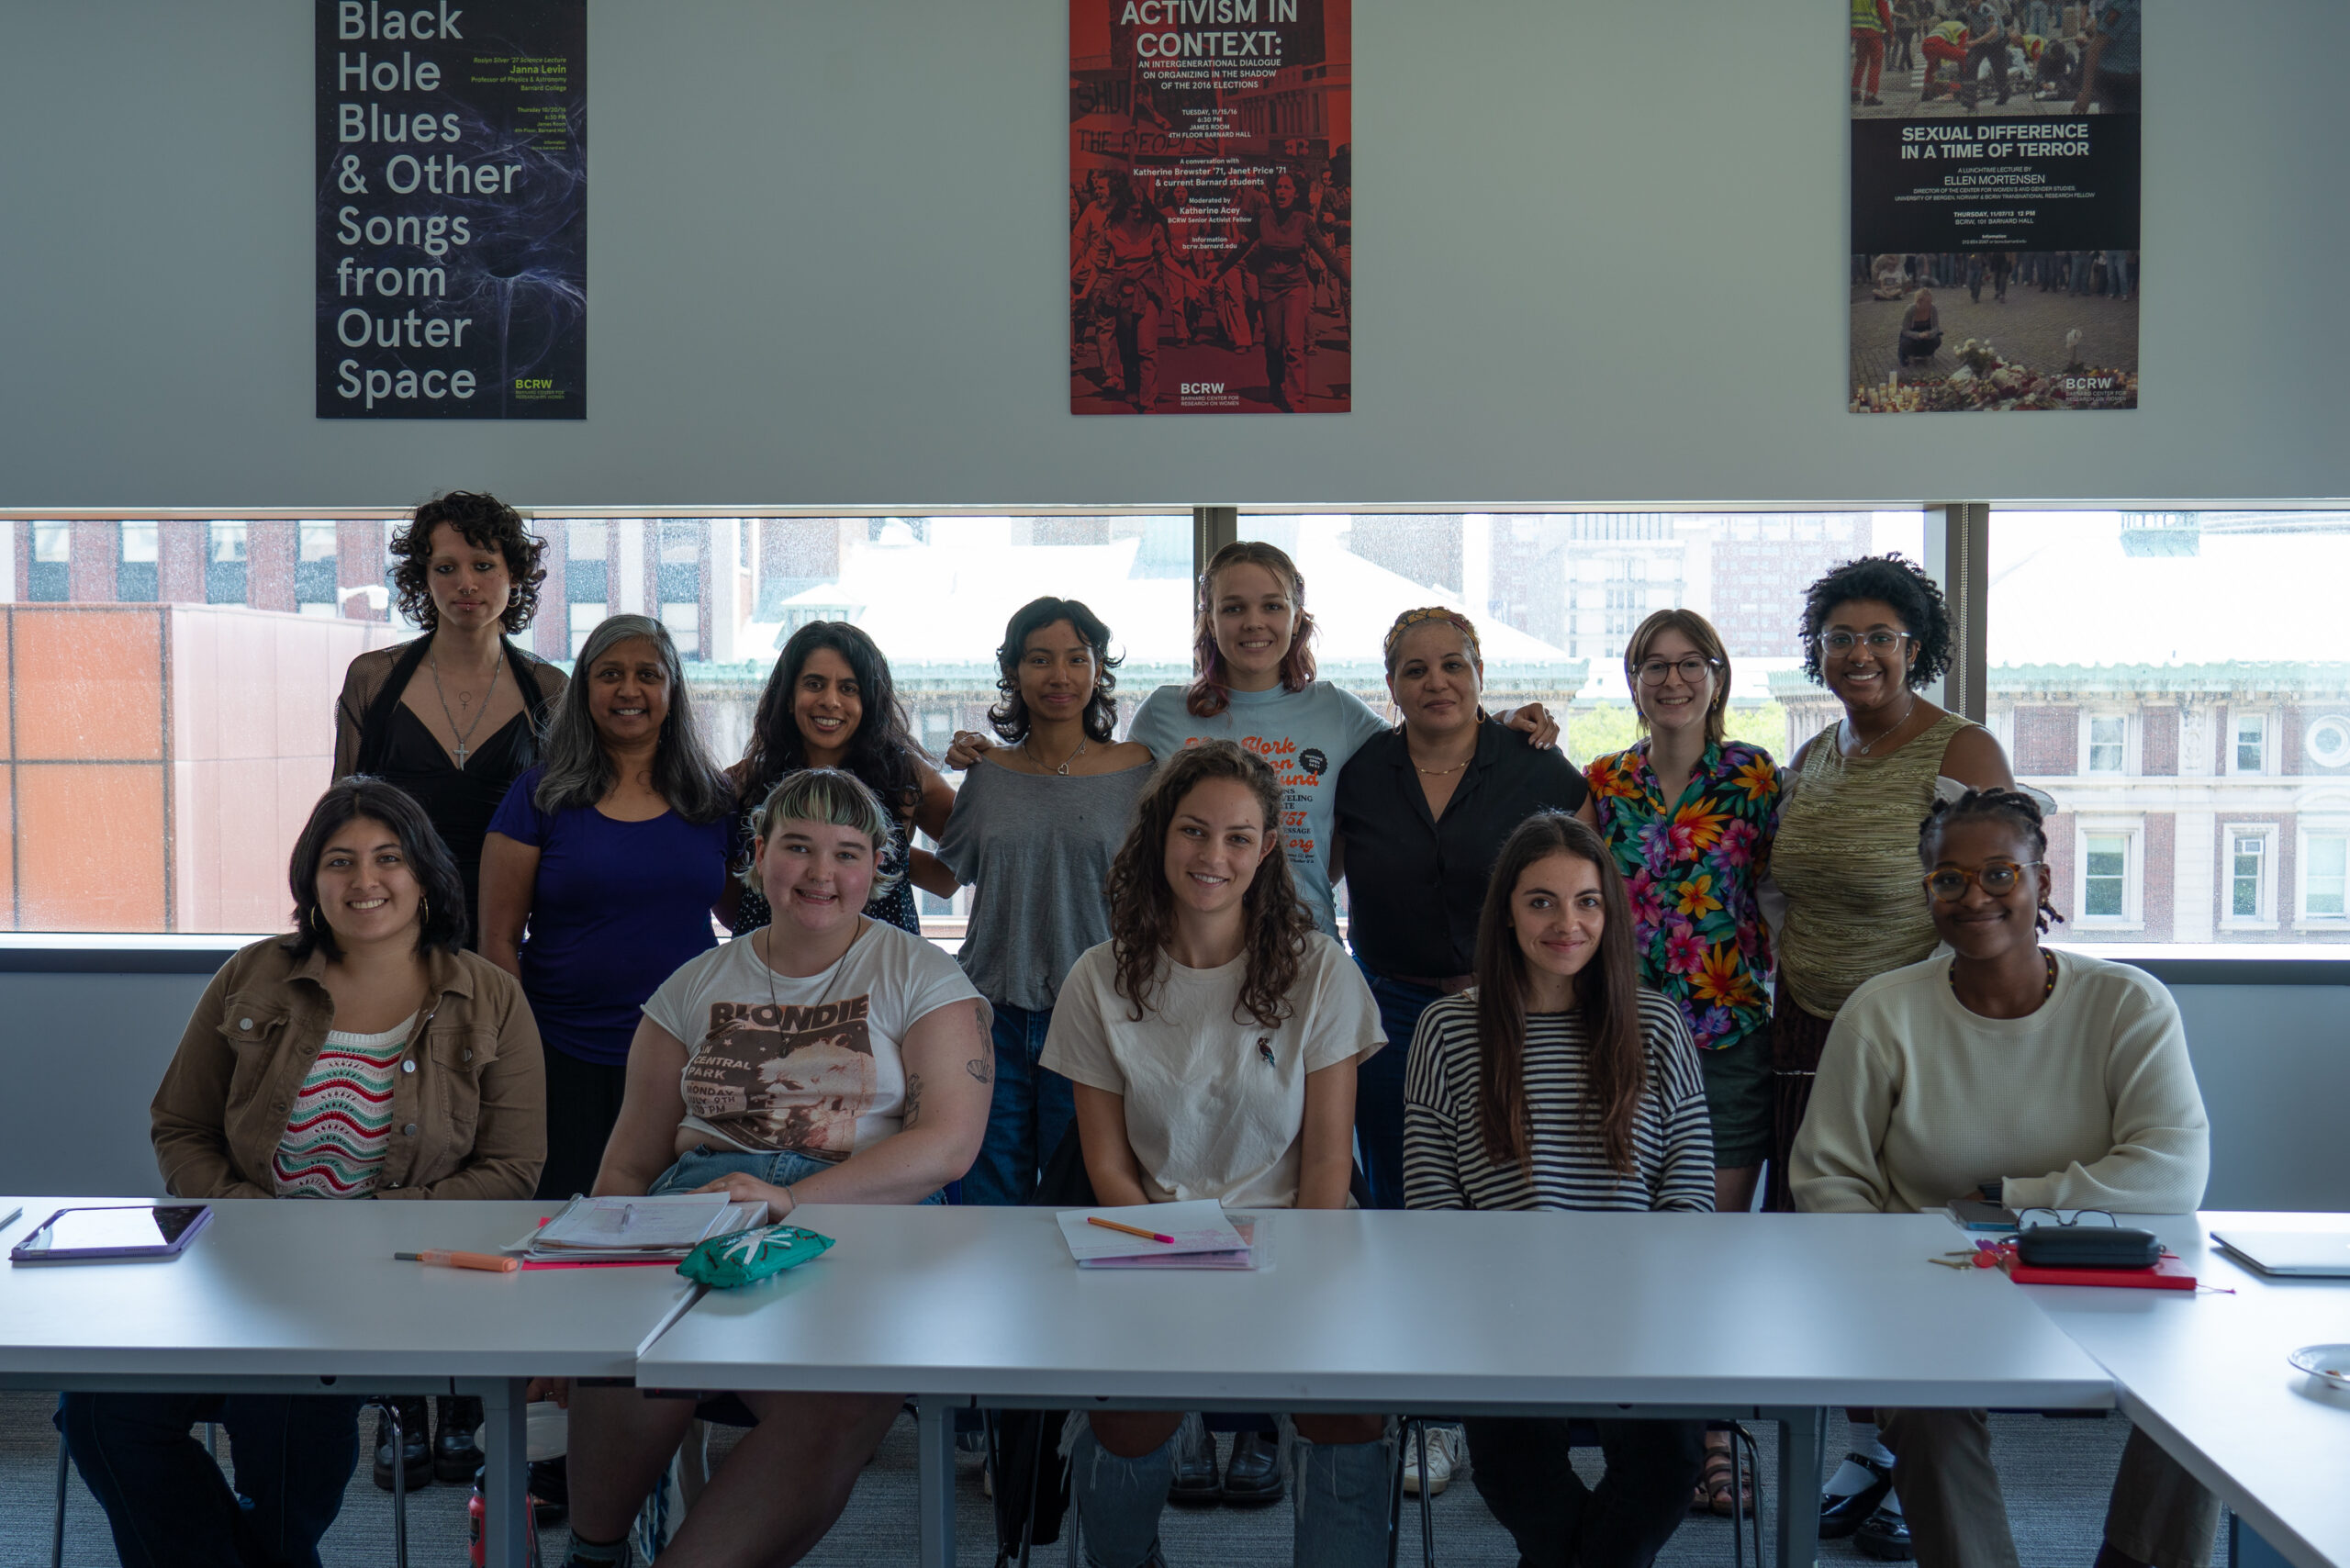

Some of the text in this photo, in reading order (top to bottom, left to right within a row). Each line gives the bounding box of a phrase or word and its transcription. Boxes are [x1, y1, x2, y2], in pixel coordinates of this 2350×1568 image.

[1121, 0, 1297, 24] ACTIVISM IN
[339, 0, 462, 40] Black
[1137, 31, 1281, 57] CONTEXT:
[510, 65, 566, 74] Janna Levin
[1152, 59, 1238, 68] INTERGENERATIONAL
[1239, 58, 1281, 67] DIALOGUE
[340, 52, 440, 91] Hole
[1143, 71, 1156, 79] ON
[1157, 71, 1210, 79] ORGANIZING
[1240, 69, 1277, 78] SHADOW
[1161, 82, 1173, 90] OF
[1174, 81, 1190, 89] THE
[1213, 80, 1259, 89] ELECTIONS
[340, 104, 461, 142] Blues
[1902, 124, 2088, 141] SEXUAL DIFFERENCE
[1902, 142, 2089, 159] IN A TIME OF TERROR
[339, 155, 522, 194] & Other
[1213, 167, 1226, 176] '71,
[1155, 179, 1161, 187] &
[1944, 174, 2045, 186] ELLEN MORTENSEN
[1220, 206, 1240, 215] Acey
[338, 206, 470, 255] Songs
[337, 257, 445, 296] from
[338, 309, 472, 347] Outer
[338, 360, 476, 409] Space
[515, 379, 552, 389] BCRW
[1181, 382, 1225, 394] BCRW
[2065, 377, 2112, 390] BCRW
[1241, 736, 1297, 755] York
[1275, 770, 1319, 786] und
[711, 994, 869, 1031] BLONDIE
[700, 1045, 713, 1054] IN
[694, 1056, 751, 1070] CENTRAL
[688, 1066, 726, 1080] PARK
[709, 1104, 725, 1114] PM
